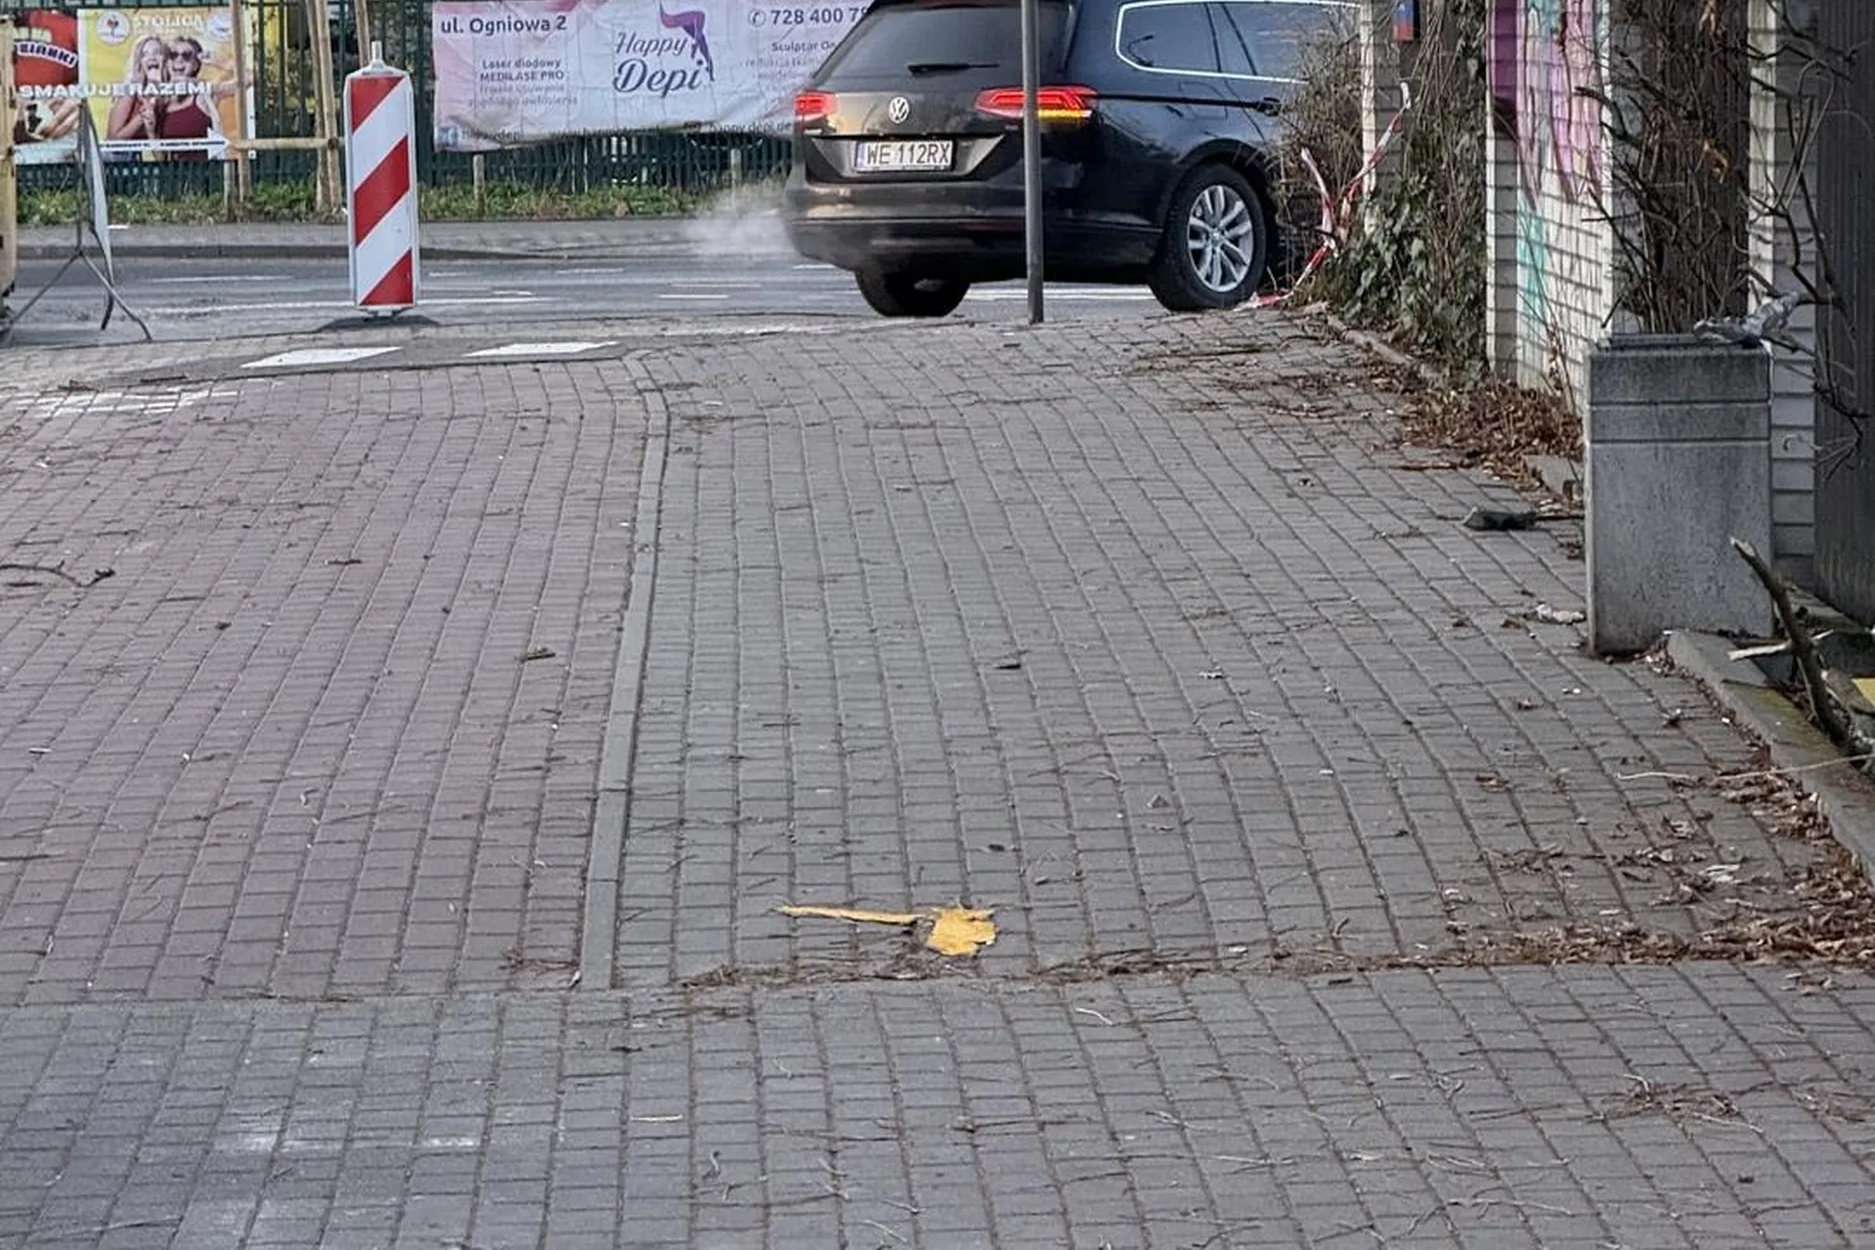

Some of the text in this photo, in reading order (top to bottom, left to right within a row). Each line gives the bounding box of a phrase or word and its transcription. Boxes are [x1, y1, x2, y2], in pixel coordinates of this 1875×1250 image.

[441, 15, 567, 36] ul. Ogniowa 2
[771, 9, 804, 25] 728
[809, 8, 843, 23] 400
[616, 32, 687, 57] Happy
[482, 58, 562, 69] Laser diodowy
[540, 70, 564, 81] PRO
[612, 58, 703, 98] Depi
[18, 81, 211, 99] SMAKUJE RAZEM!
[867, 143, 950, 164] WE 112RX
